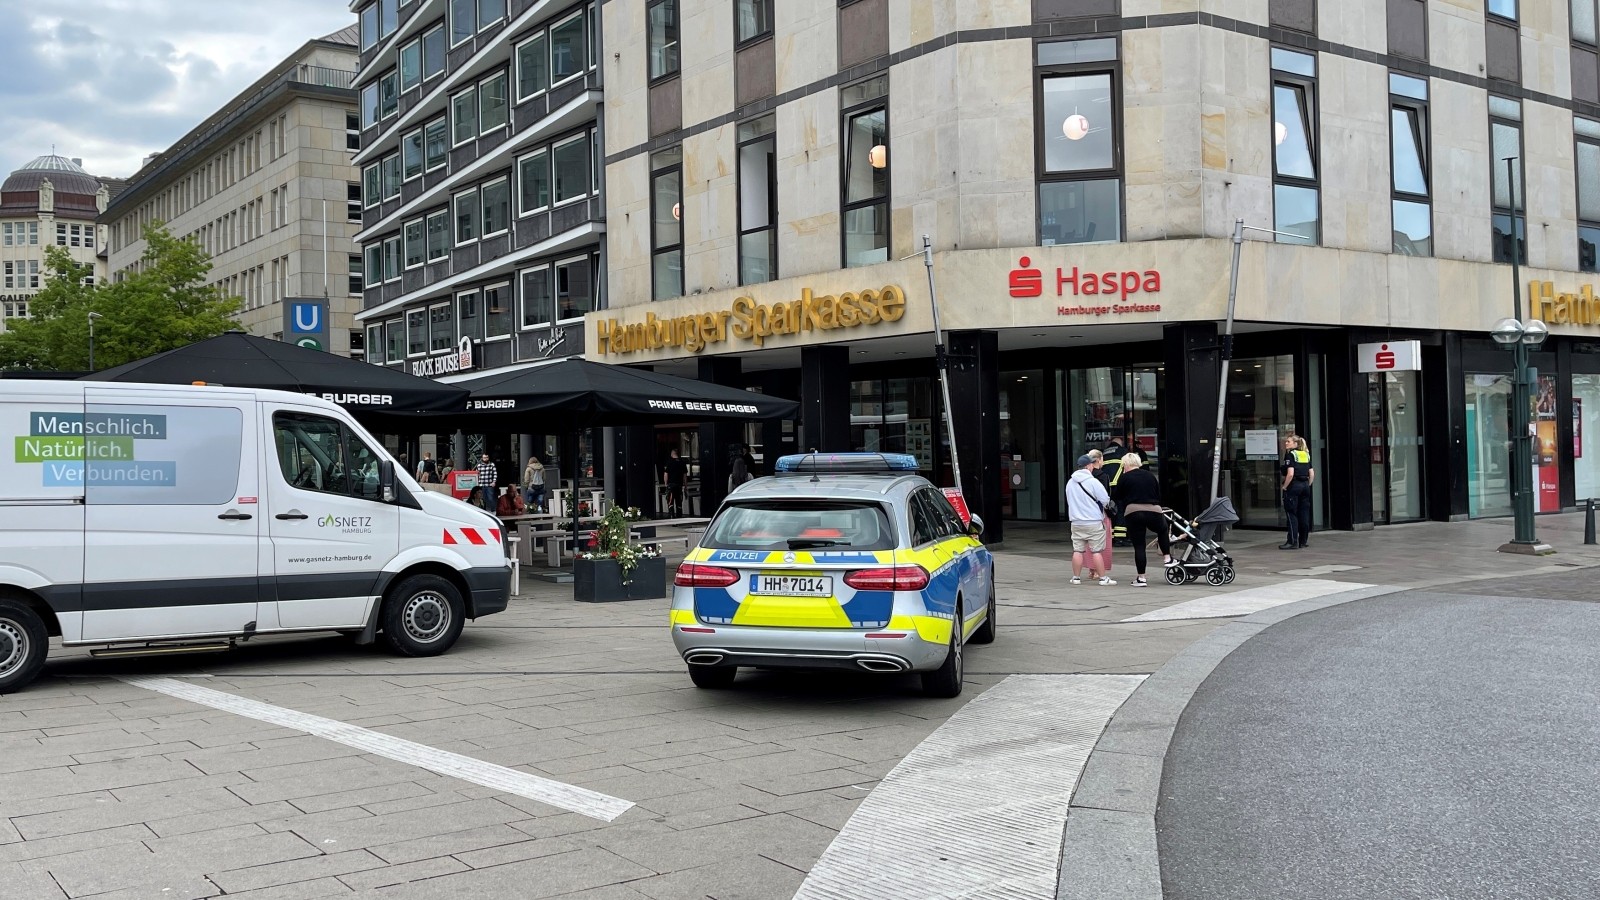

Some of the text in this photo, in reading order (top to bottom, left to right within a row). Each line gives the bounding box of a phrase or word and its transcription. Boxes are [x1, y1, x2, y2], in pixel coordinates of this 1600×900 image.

[1056, 267, 1161, 301] Haspa
[1057, 303, 1161, 316] Hamburger Sparkasse
[296, 305, 318, 331] U
[597, 284, 906, 354] Hamburger Sparkasse
[412, 358, 434, 377] BLOCK
[434, 353, 459, 375] HOUSE
[322, 393, 393, 405] BURGER
[474, 400, 515, 409] BURGER
[648, 400, 758, 413] PRIME BEEF BURGER
[38, 416, 159, 435] Menschlich.
[24, 440, 127, 457] Natürlich.
[51, 464, 169, 481] Verbunden.
[317, 513, 372, 527] GASNETZ
[288, 554, 372, 563] www.gasnetz-hamburg.de
[720, 552, 758, 560] POLIZEI
[790, 578, 823, 592] 7014
